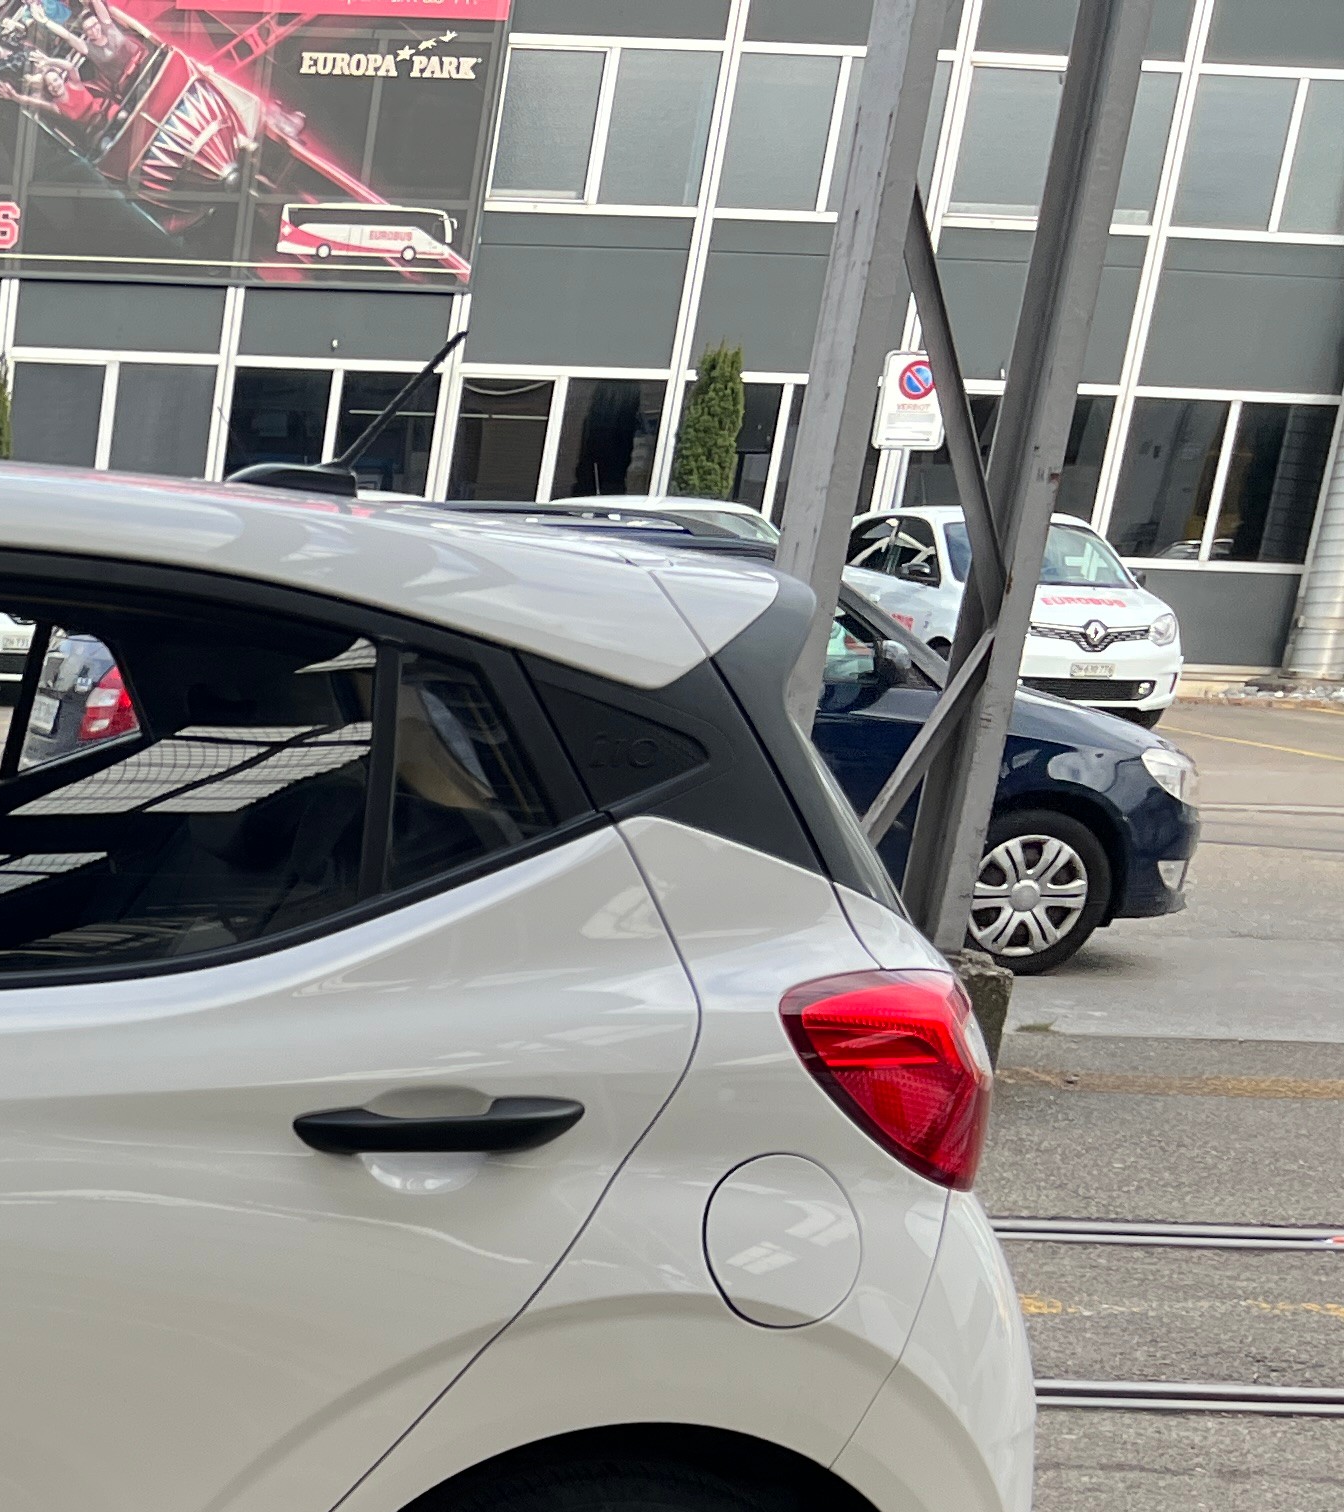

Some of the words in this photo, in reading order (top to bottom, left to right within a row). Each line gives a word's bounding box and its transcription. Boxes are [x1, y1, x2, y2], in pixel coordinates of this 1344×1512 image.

[299, 51, 398, 77] EUROPA
[369, 230, 413, 242] EUROBUS
[1040, 596, 1127, 608] EUROBUS
